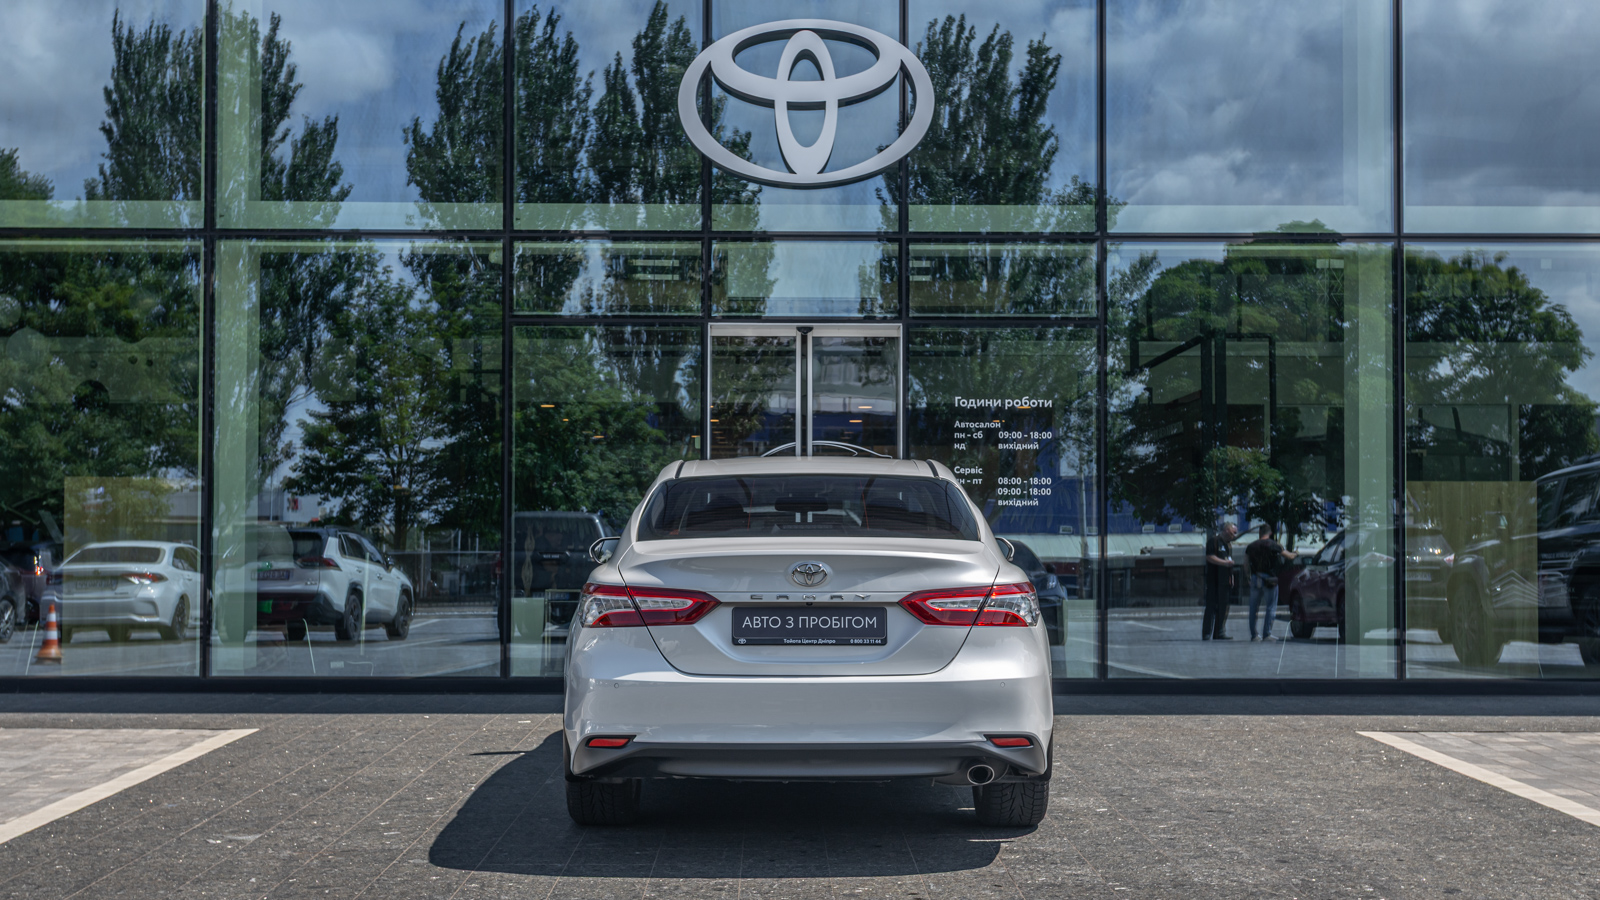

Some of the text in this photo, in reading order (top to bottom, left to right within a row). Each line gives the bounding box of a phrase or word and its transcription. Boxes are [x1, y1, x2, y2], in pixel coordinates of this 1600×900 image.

[955, 396, 1053, 410] Години роботи
[954, 420, 1001, 429] Автосалон
[973, 431, 984, 439] сб
[998, 431, 1022, 439] 09:00
[1030, 431, 1053, 439] 18:00
[954, 442, 1039, 451] нд вихідний
[954, 466, 983, 475] Сервіс
[998, 477, 1022, 485] 08:00
[1029, 477, 1052, 485] 18:00
[997, 488, 1022, 496] 09:00
[1029, 488, 1052, 496] 18:00
[998, 498, 1039, 507] вихідний
[742, 616, 781, 628] АВТО
[799, 616, 877, 628] ПРОБІГОМ
